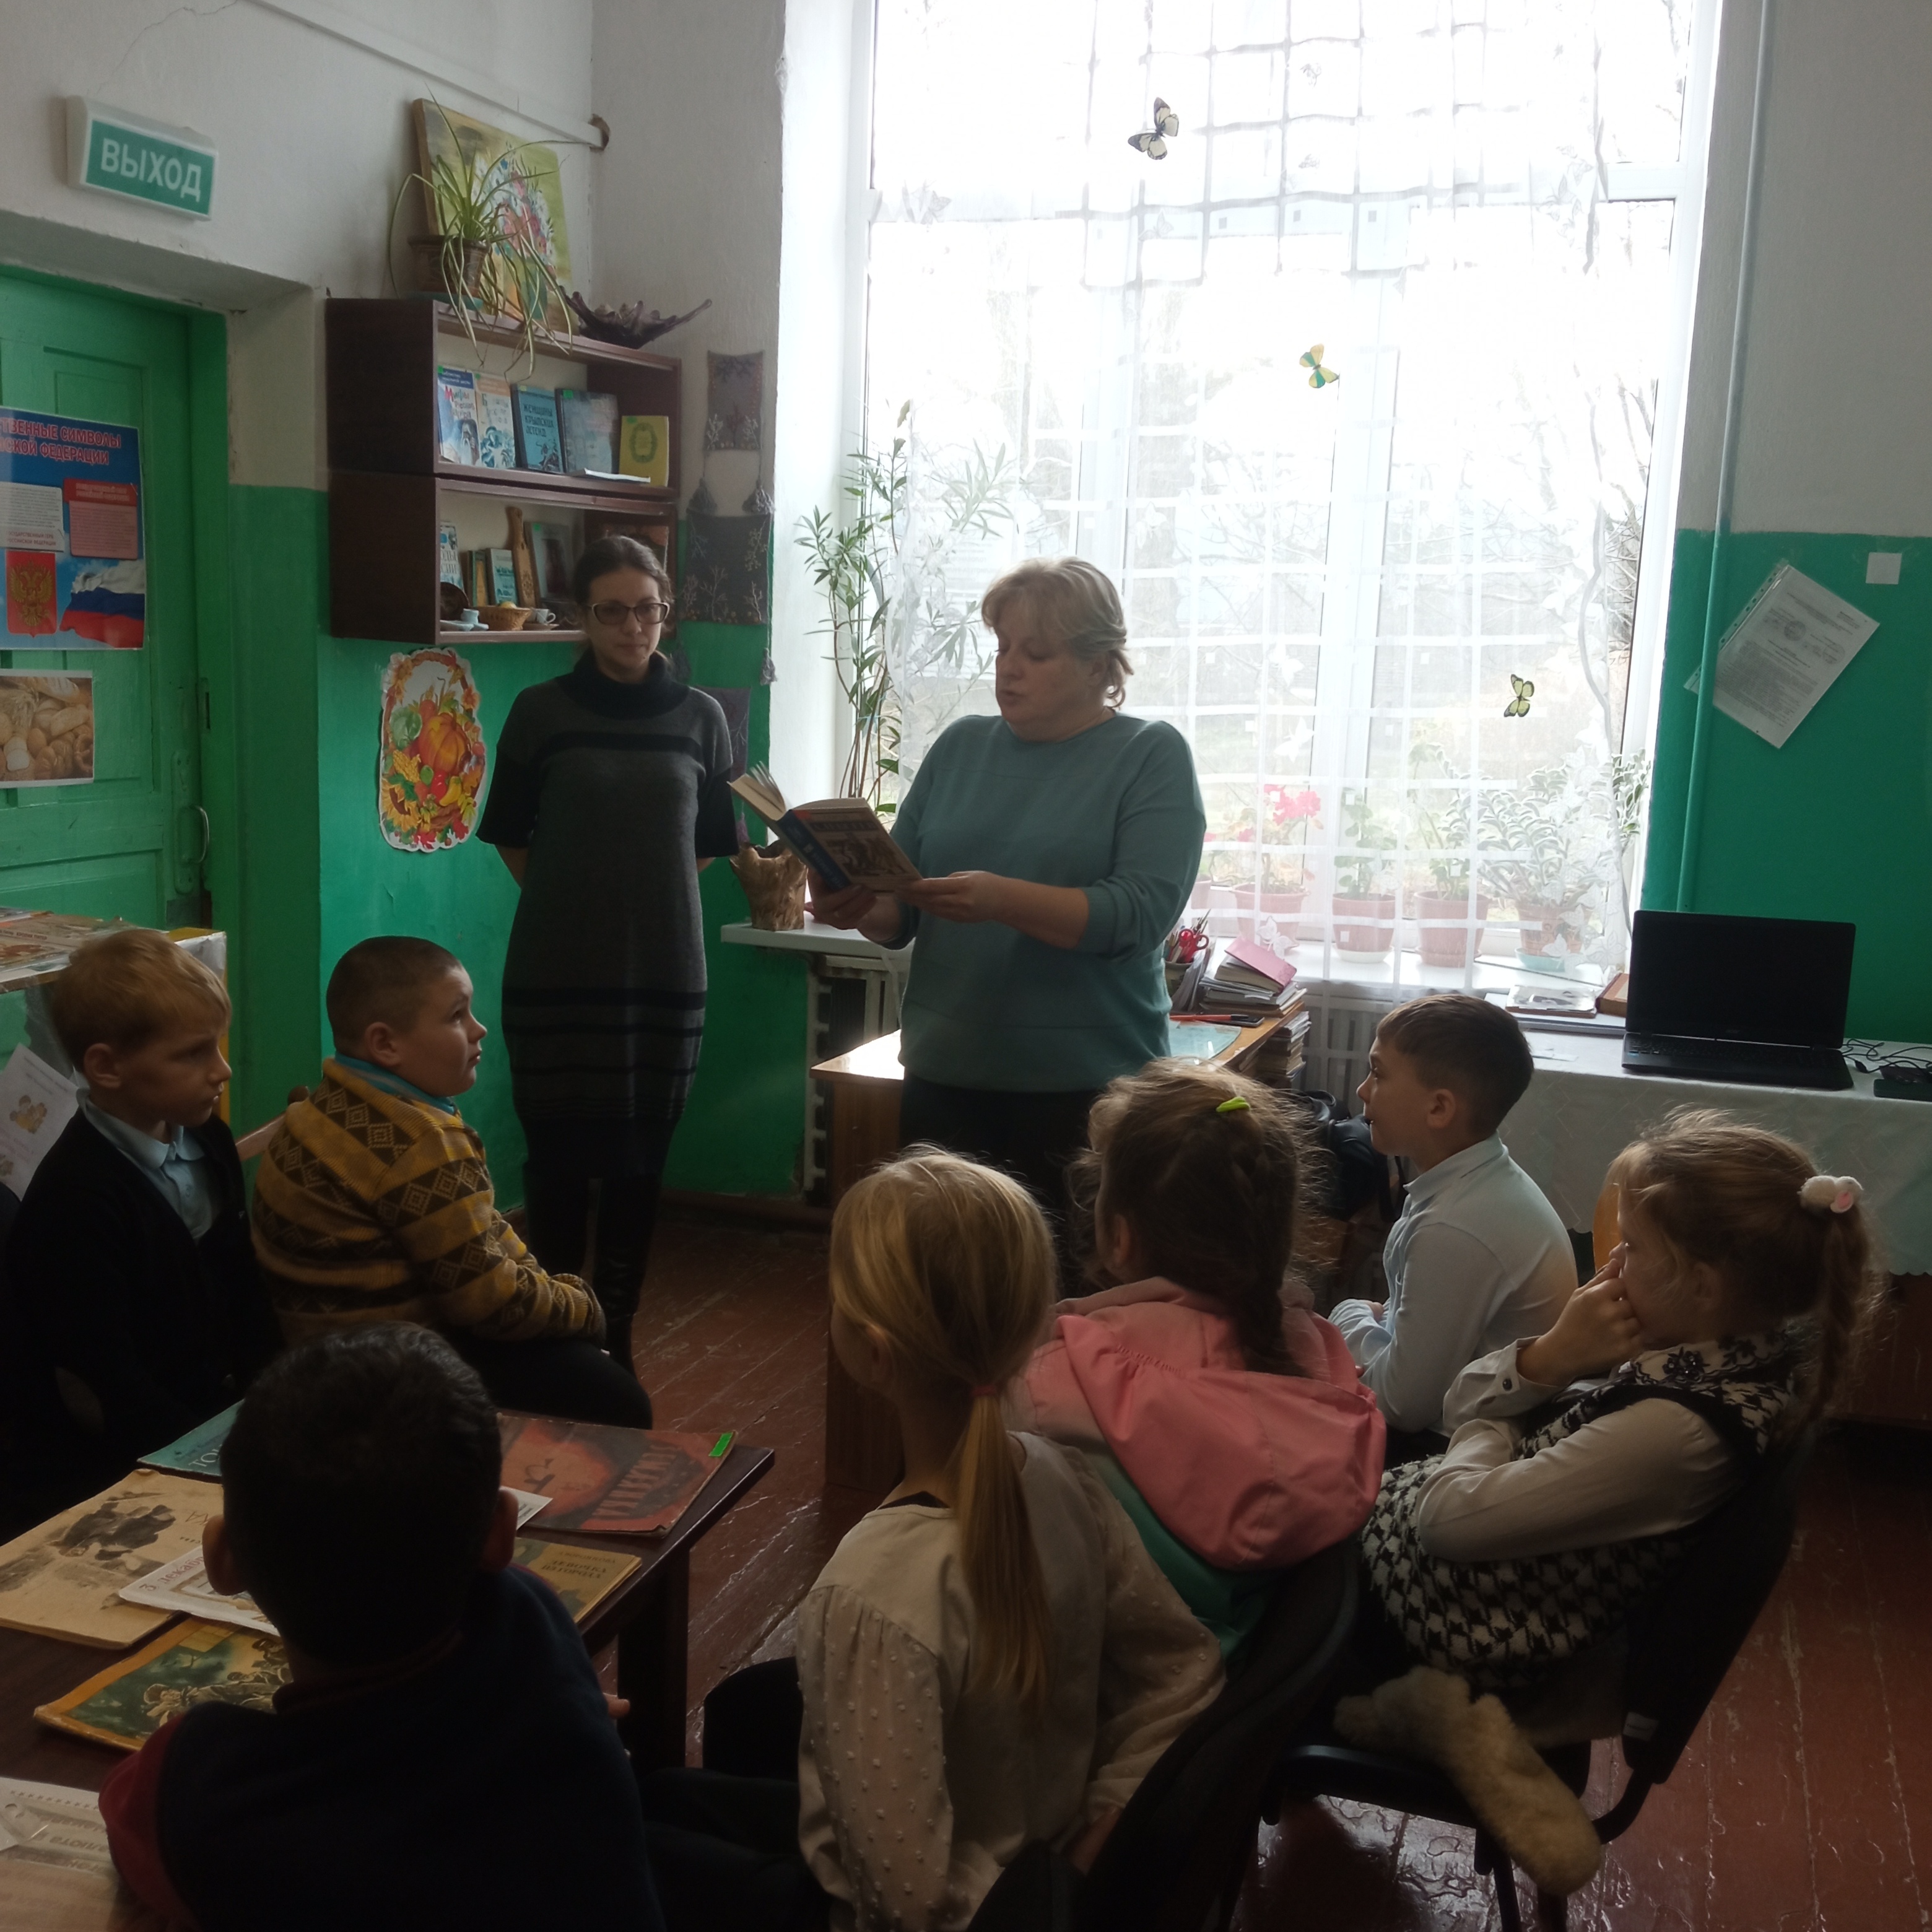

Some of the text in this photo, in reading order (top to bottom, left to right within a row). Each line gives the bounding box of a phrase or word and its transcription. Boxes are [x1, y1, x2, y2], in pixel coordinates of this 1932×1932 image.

[100, 137, 202, 203] ВЫХОД
[523, 404, 552, 417] ЖЕНЩИНЫ
[524, 415, 554, 428] КРЫМСКИХ
[0, 417, 122, 449] ТВЕННЫЕ СИМВОЛЫ
[526, 425, 547, 437] ЛЕГЕНД
[40, 442, 110, 466] ФЕДЕРАЦИИ
[552, 1560, 607, 1573] ДЕВОЧКА
[556, 1567, 601, 1579] ГОРОДА
